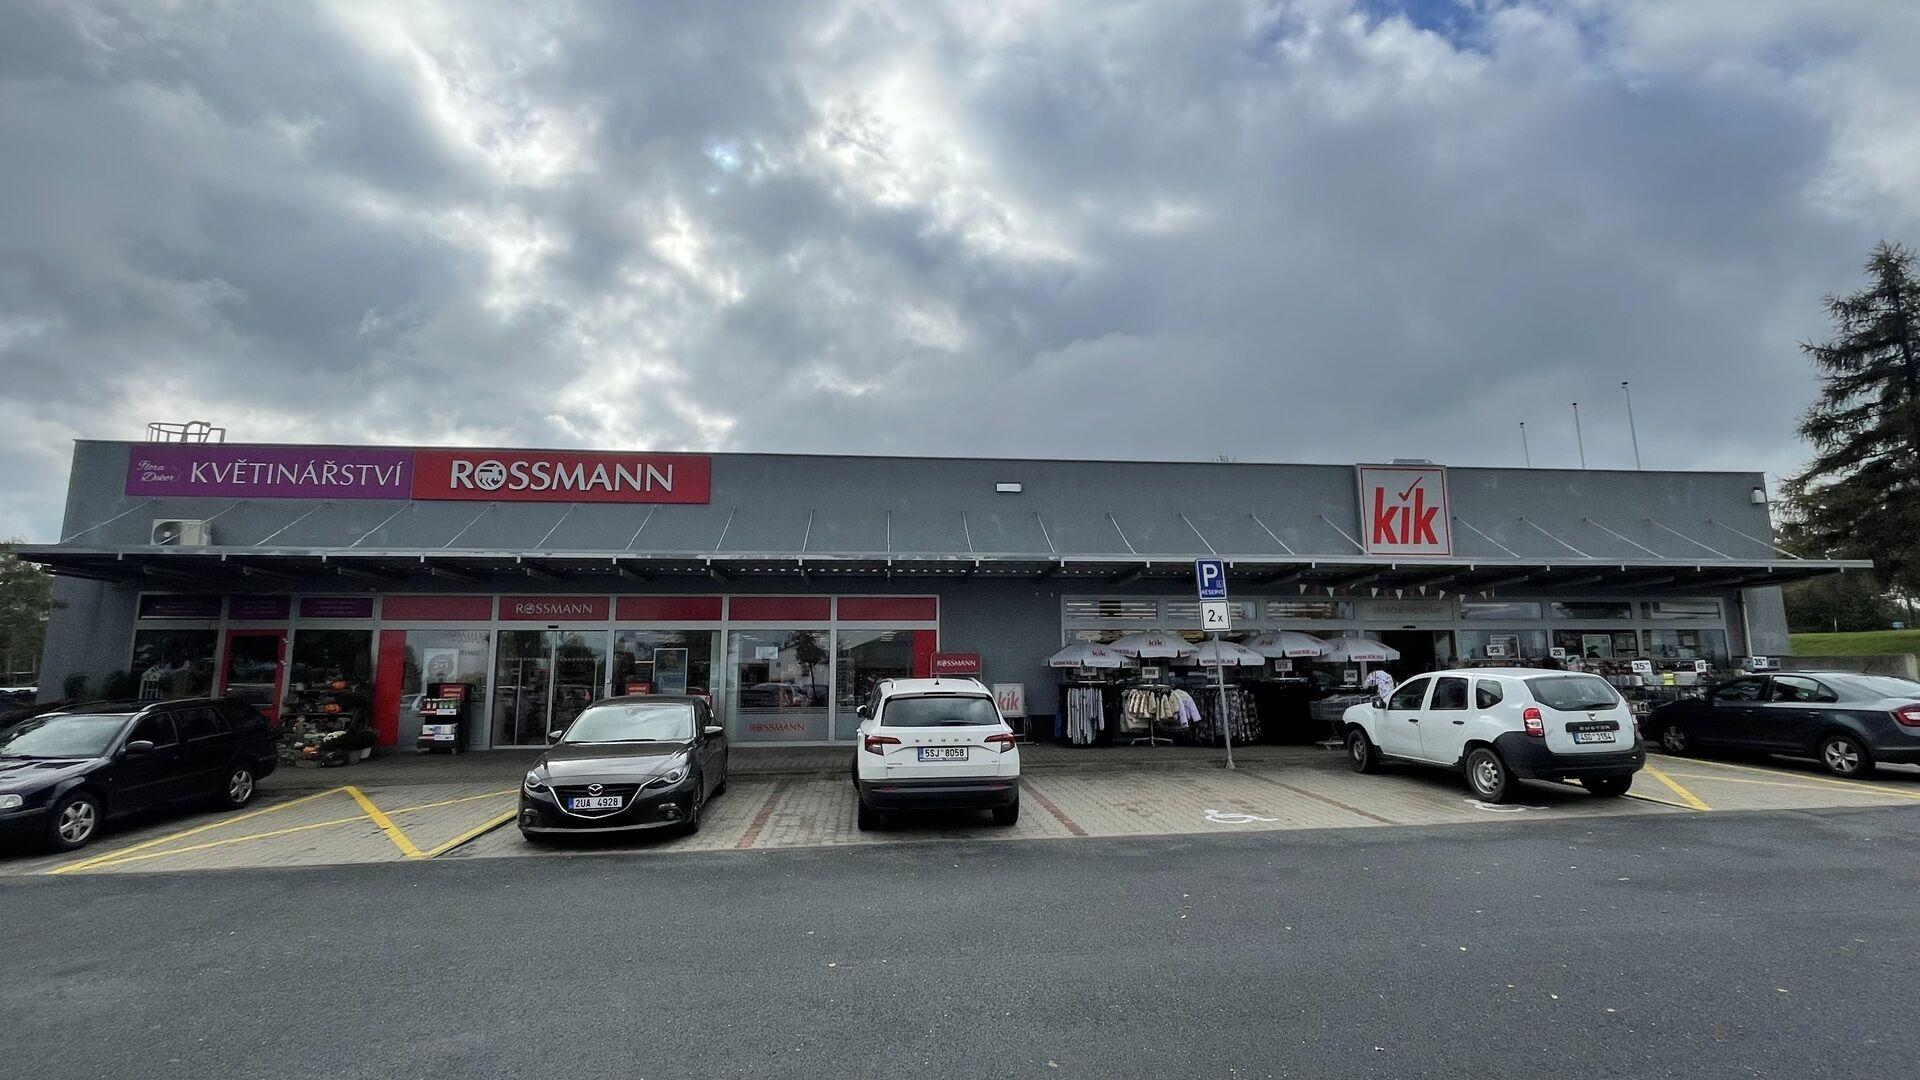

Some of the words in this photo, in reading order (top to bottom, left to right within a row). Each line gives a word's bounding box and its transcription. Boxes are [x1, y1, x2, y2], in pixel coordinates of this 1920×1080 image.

[190, 458, 404, 486] KVĚTINÁŘSTVÍ
[450, 459, 674, 491] ROSSMANN
[1372, 477, 1440, 545] kik
[1202, 563, 1219, 587] P
[515, 602, 593, 614] ROSSMANN
[936, 659, 976, 667] ROSSMANN
[1633, 662, 1645, 671] 35
[997, 688, 1020, 711] kik
[748, 722, 806, 733] ROSSMANN
[925, 748, 940, 758] 5SJ
[945, 748, 965, 757] 8058
[575, 799, 591, 808] 2UA
[597, 797, 619, 807] 4928
